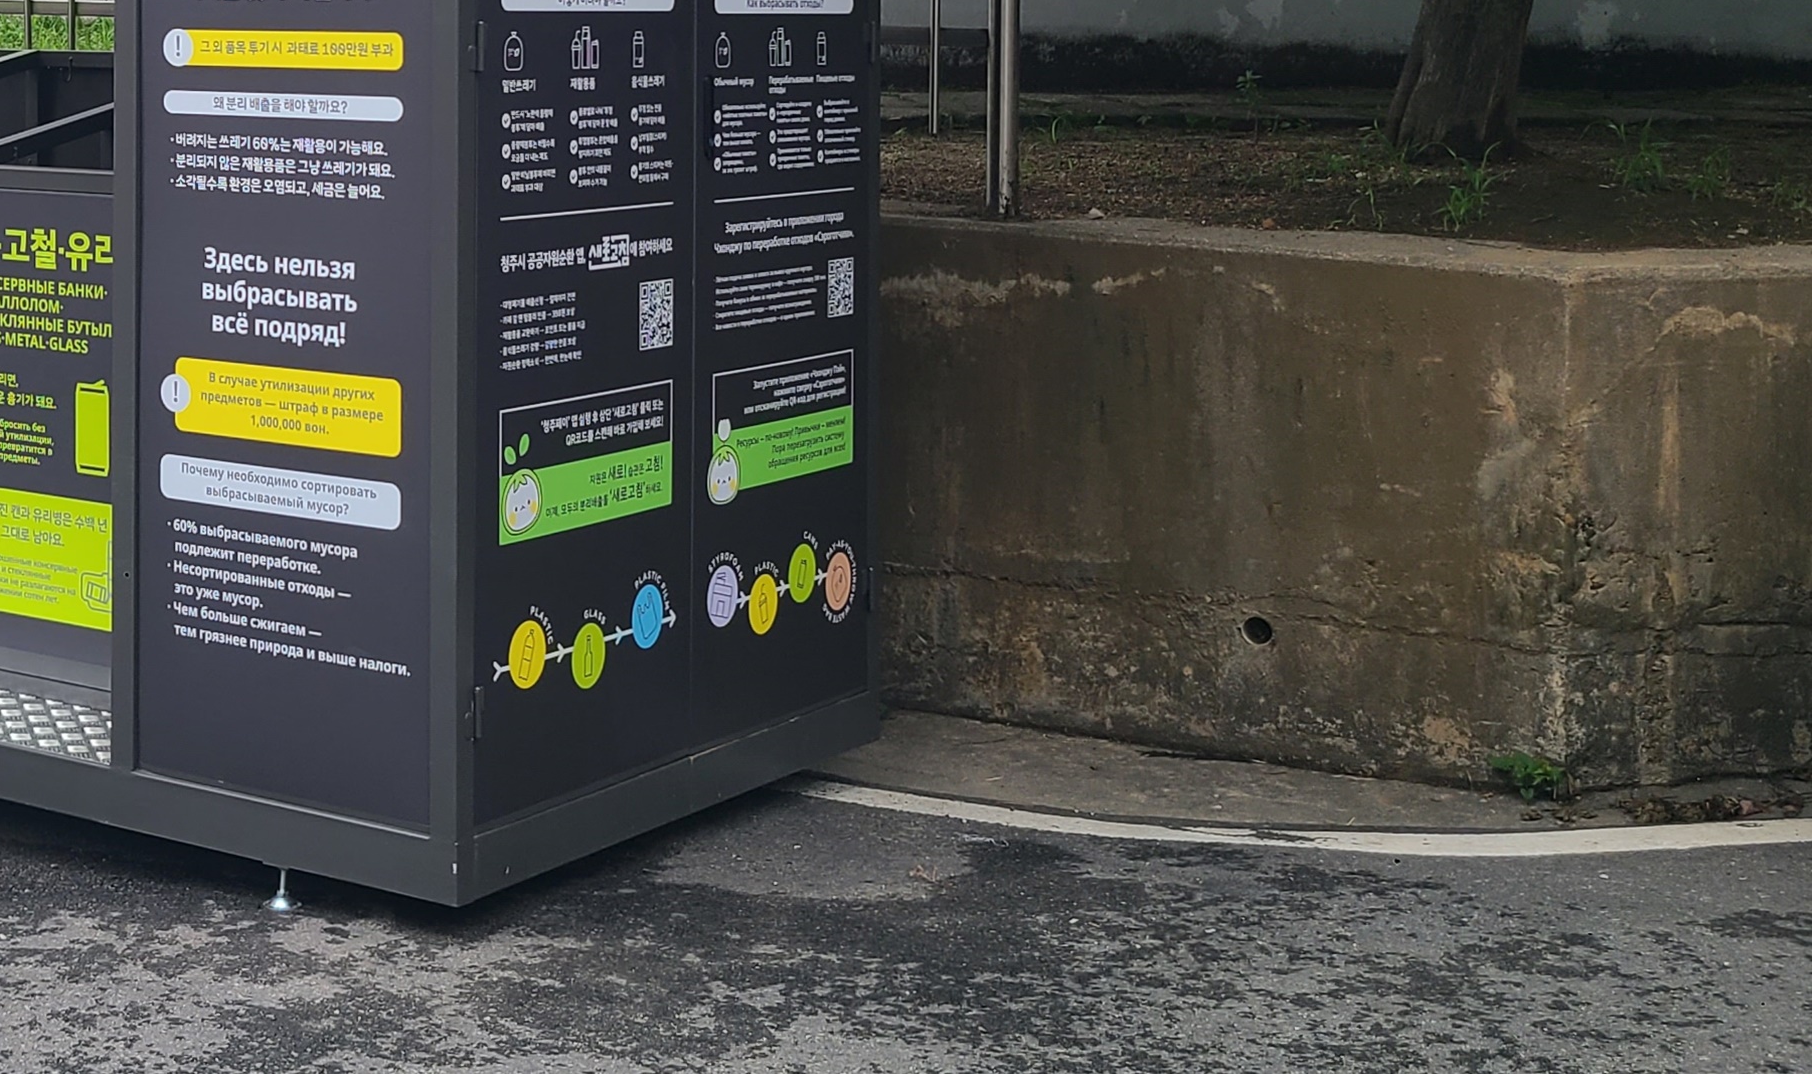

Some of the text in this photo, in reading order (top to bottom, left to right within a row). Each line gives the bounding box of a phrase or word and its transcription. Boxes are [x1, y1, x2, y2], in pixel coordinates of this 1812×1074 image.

[200, 41, 210, 53] 그
[212, 41, 223, 53] 외
[226, 41, 246, 54] 품목
[249, 41, 269, 55] 투기
[272, 42, 283, 54] 시
[287, 42, 320, 55] 과태료
[371, 43, 394, 57] 부과
[213, 96, 347, 114] 왜 분리 배출을 해야 할까요?
[175, 133, 388, 156] 버려지는 쓰레기 60%는 재활용이 가능해요.
[175, 153, 217, 168] 분리되지
[218, 155, 240, 171] 않은
[241, 157, 296, 174] 재활용품은
[297, 159, 320, 175] 그냥
[321, 161, 367, 176] 쓰레기가
[175, 174, 384, 199] 소각될수록 환경은 오염되고, 세금은 늘어요.
[204, 247, 354, 279] Здесь нельзя
[202, 280, 357, 311] выбрасывать
[212, 312, 345, 346] всё подряд!
[208, 371, 374, 401] В случае утилизации других
[200, 392, 383, 423] предметов штраф в размере
[32, 422, 45, 433] без
[250, 414, 329, 434] 1,000,000 вон.
[6, 432, 54, 446] утилизации,
[48, 448, 53, 456] в
[181, 462, 376, 498] Почему необходимо сортировать
[206, 486, 349, 517] выбрасываемый мусор?
[173, 518, 357, 560] 60% выбрасываемого мусора
[803, 531, 818, 550] CANS
[174, 542, 321, 574] подлежит переработке.
[754, 561, 780, 577] PLASTIC
[173, 560, 334, 598] Несортированные отходы
[634, 570, 662, 589] PLASTIC
[174, 583, 263, 610] это уже мусор.
[173, 601, 306, 636] Чем больше сжигаем
[530, 606, 553, 645] PLASTIC
[584, 609, 606, 625] GLASS
[174, 624, 410, 676] тем грязнее природа и выше налоги.
